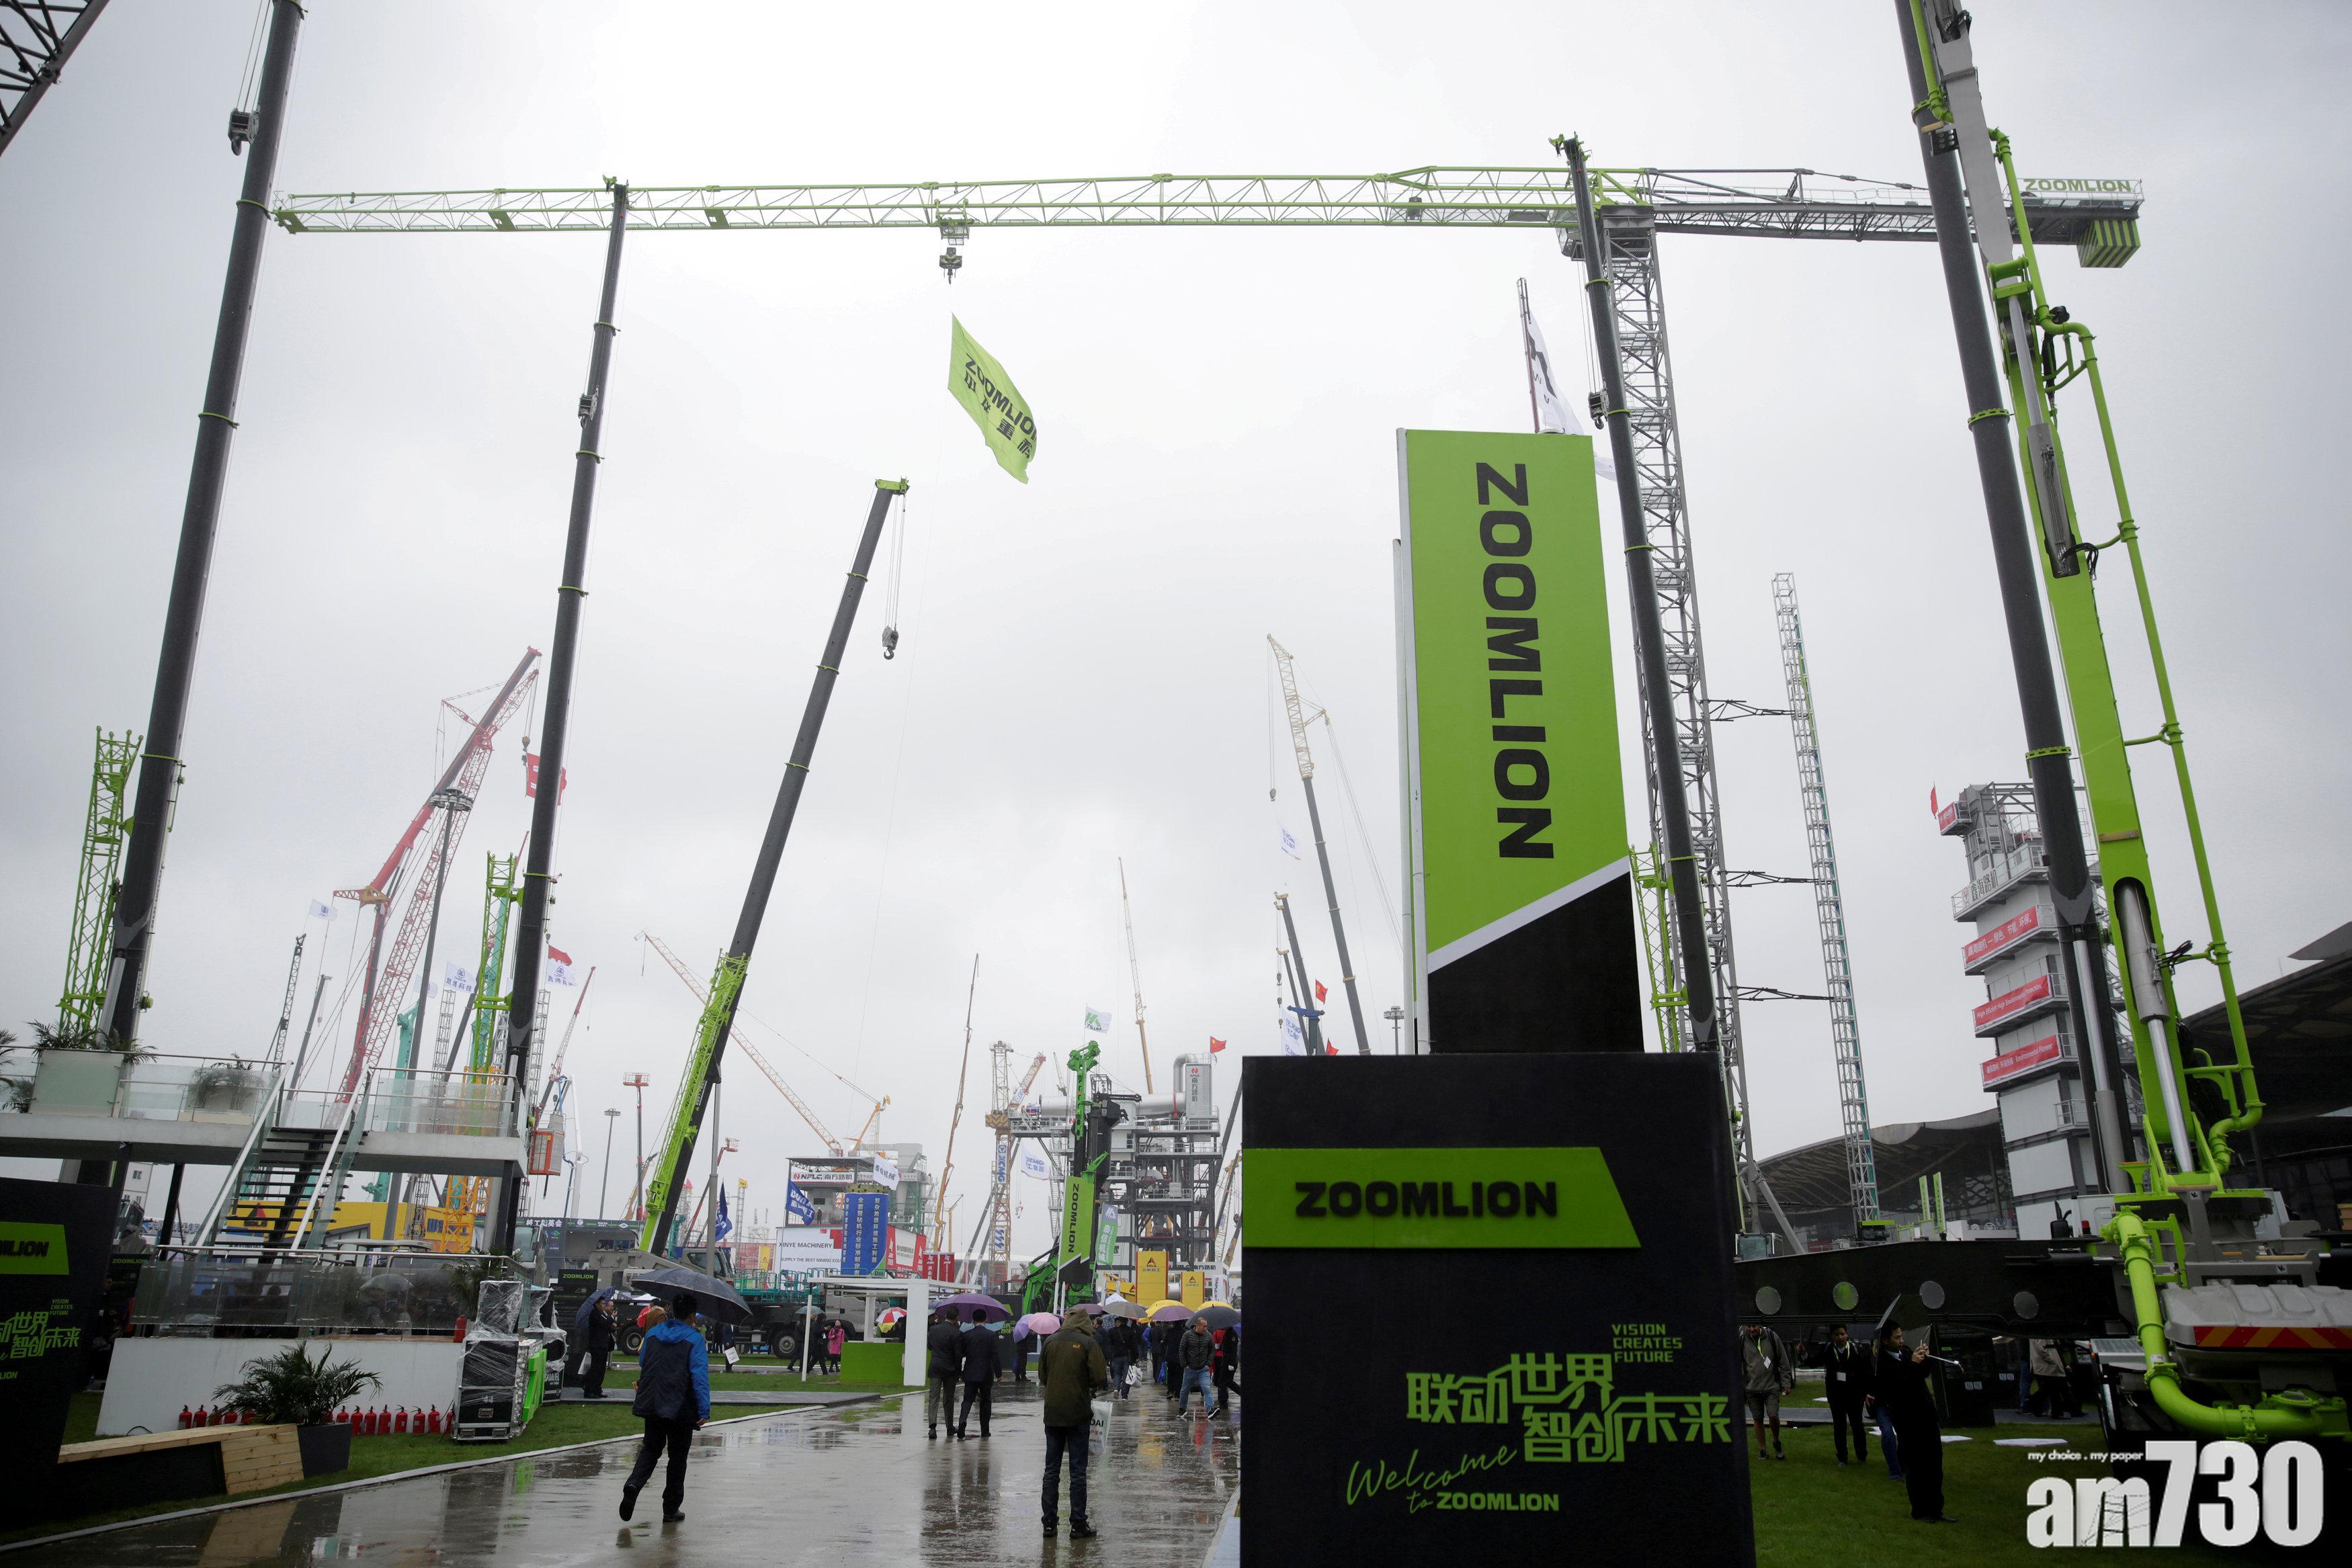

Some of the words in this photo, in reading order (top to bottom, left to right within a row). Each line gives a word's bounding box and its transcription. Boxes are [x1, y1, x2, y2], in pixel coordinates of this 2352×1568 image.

[2024, 179, 2130, 192] ZOOMLION
[1476, 462, 1554, 859] ZOOMLION
[1971, 869, 1999, 902] 鑫海路机
[1295, 1181, 1558, 1217] ZOOMLION
[1068, 1184, 1079, 1253] ZOOMLION
[1611, 1324, 1666, 1336] VISION
[1613, 1337, 1682, 1350] CREATES
[1614, 1351, 1673, 1363] FUTURE
[1406, 1353, 1615, 1424] 联动世界
[1521, 1392, 1732, 1463] 智创未来
[1347, 1444, 1517, 1506] Welcome
[1406, 1491, 1434, 1514] to
[1437, 1492, 1559, 1512] ZOOMLION
